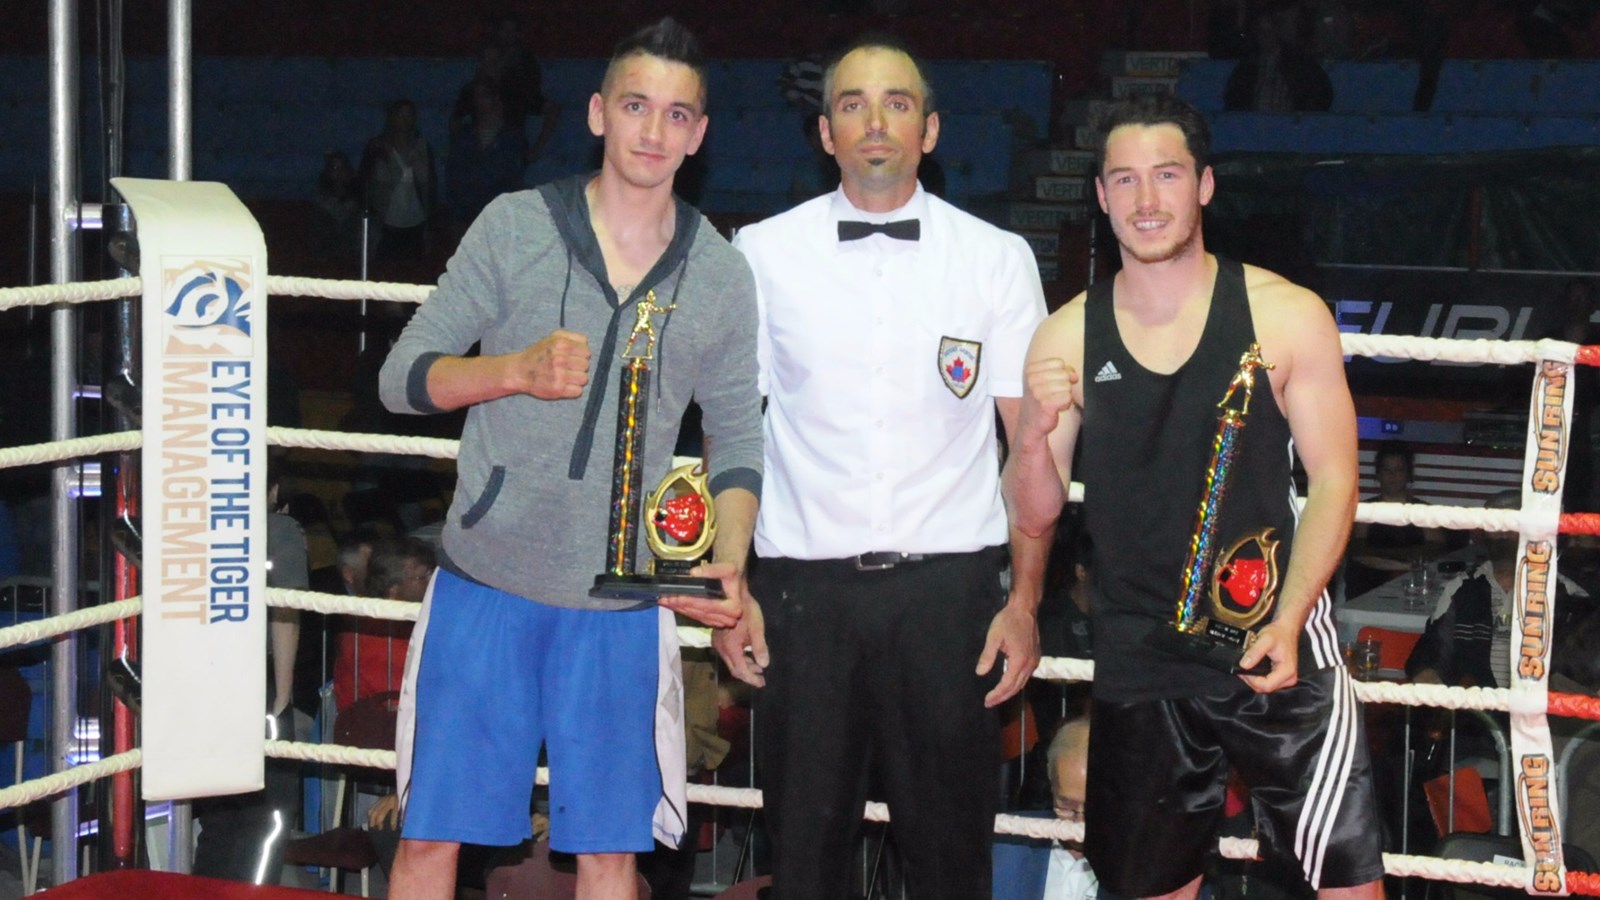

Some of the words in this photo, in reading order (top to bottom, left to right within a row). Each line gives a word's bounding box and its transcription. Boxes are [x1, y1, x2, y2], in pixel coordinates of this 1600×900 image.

[211, 360, 251, 420] EYE
[1094, 372, 1122, 383] adidas
[210, 427, 251, 467] OF
[1532, 429, 1560, 493] SUN
[161, 362, 208, 624] MANAGEMENT
[210, 471, 250, 532] THE
[210, 536, 250, 624] TIGER
[1524, 541, 1552, 615] RING
[1518, 616, 1545, 679] SUN
[1521, 754, 1552, 829] RING
